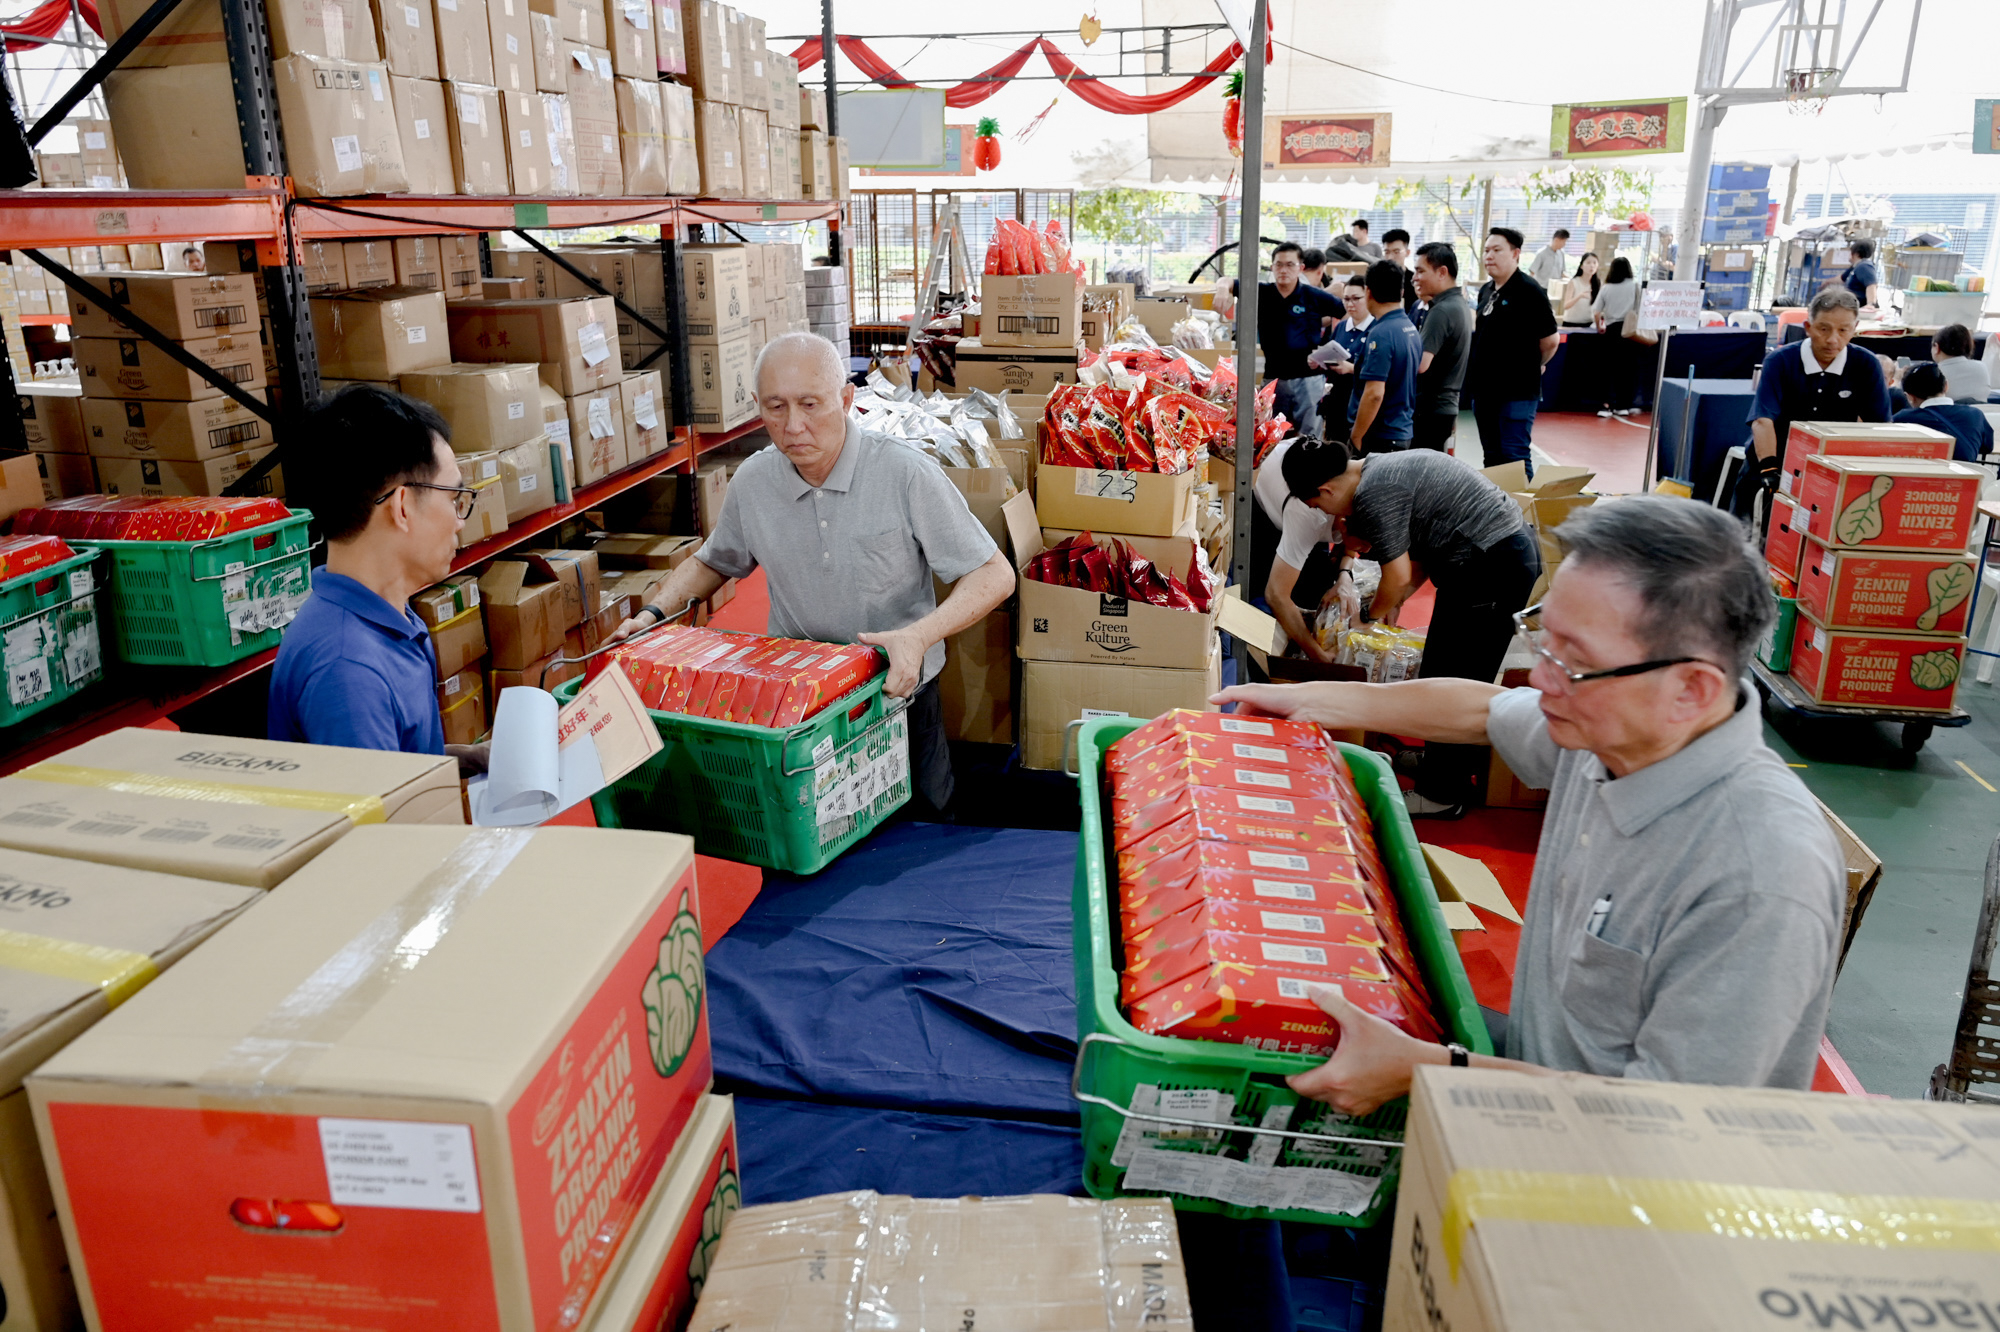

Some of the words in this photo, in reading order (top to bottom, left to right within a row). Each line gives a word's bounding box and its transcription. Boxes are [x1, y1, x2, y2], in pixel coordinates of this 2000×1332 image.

[1285, 132, 1372, 149] 大自然的礼物
[1680, 300, 1699, 308] Point
[119, 369, 142, 378] Green
[1004, 371, 1034, 379] Kulture
[117, 376, 144, 386] Kulture
[1005, 378, 1030, 387] Green
[125, 430, 148, 439] Green
[123, 437, 150, 446] Kulture
[1905, 491, 1960, 503] PRODUCE
[1902, 503, 1957, 515] ORGANIC
[1899, 515, 1955, 529] ZENXIN
[1853, 577, 1910, 592] ZENXIN
[1851, 591, 1907, 604] ORGANIC
[1849, 603, 1905, 616] PRODUCE
[1091, 620, 1128, 632] Green
[1085, 631, 1130, 645] Kulture
[1844, 655, 1899, 670] ZENXIN
[838, 671, 857, 688] ZENXIN
[1842, 669, 1896, 681] ORGANIC
[1839, 681, 1893, 692] PRODUCE
[175, 751, 301, 771] BlackMo
[1280, 1021, 1334, 1035] ZENXIN
[546, 1031, 633, 1194] ZENXIN
[554, 1083, 638, 1238] ORGANIC
[559, 1124, 642, 1286] PRODUCE
[1142, 1263, 1167, 1325] MADE
